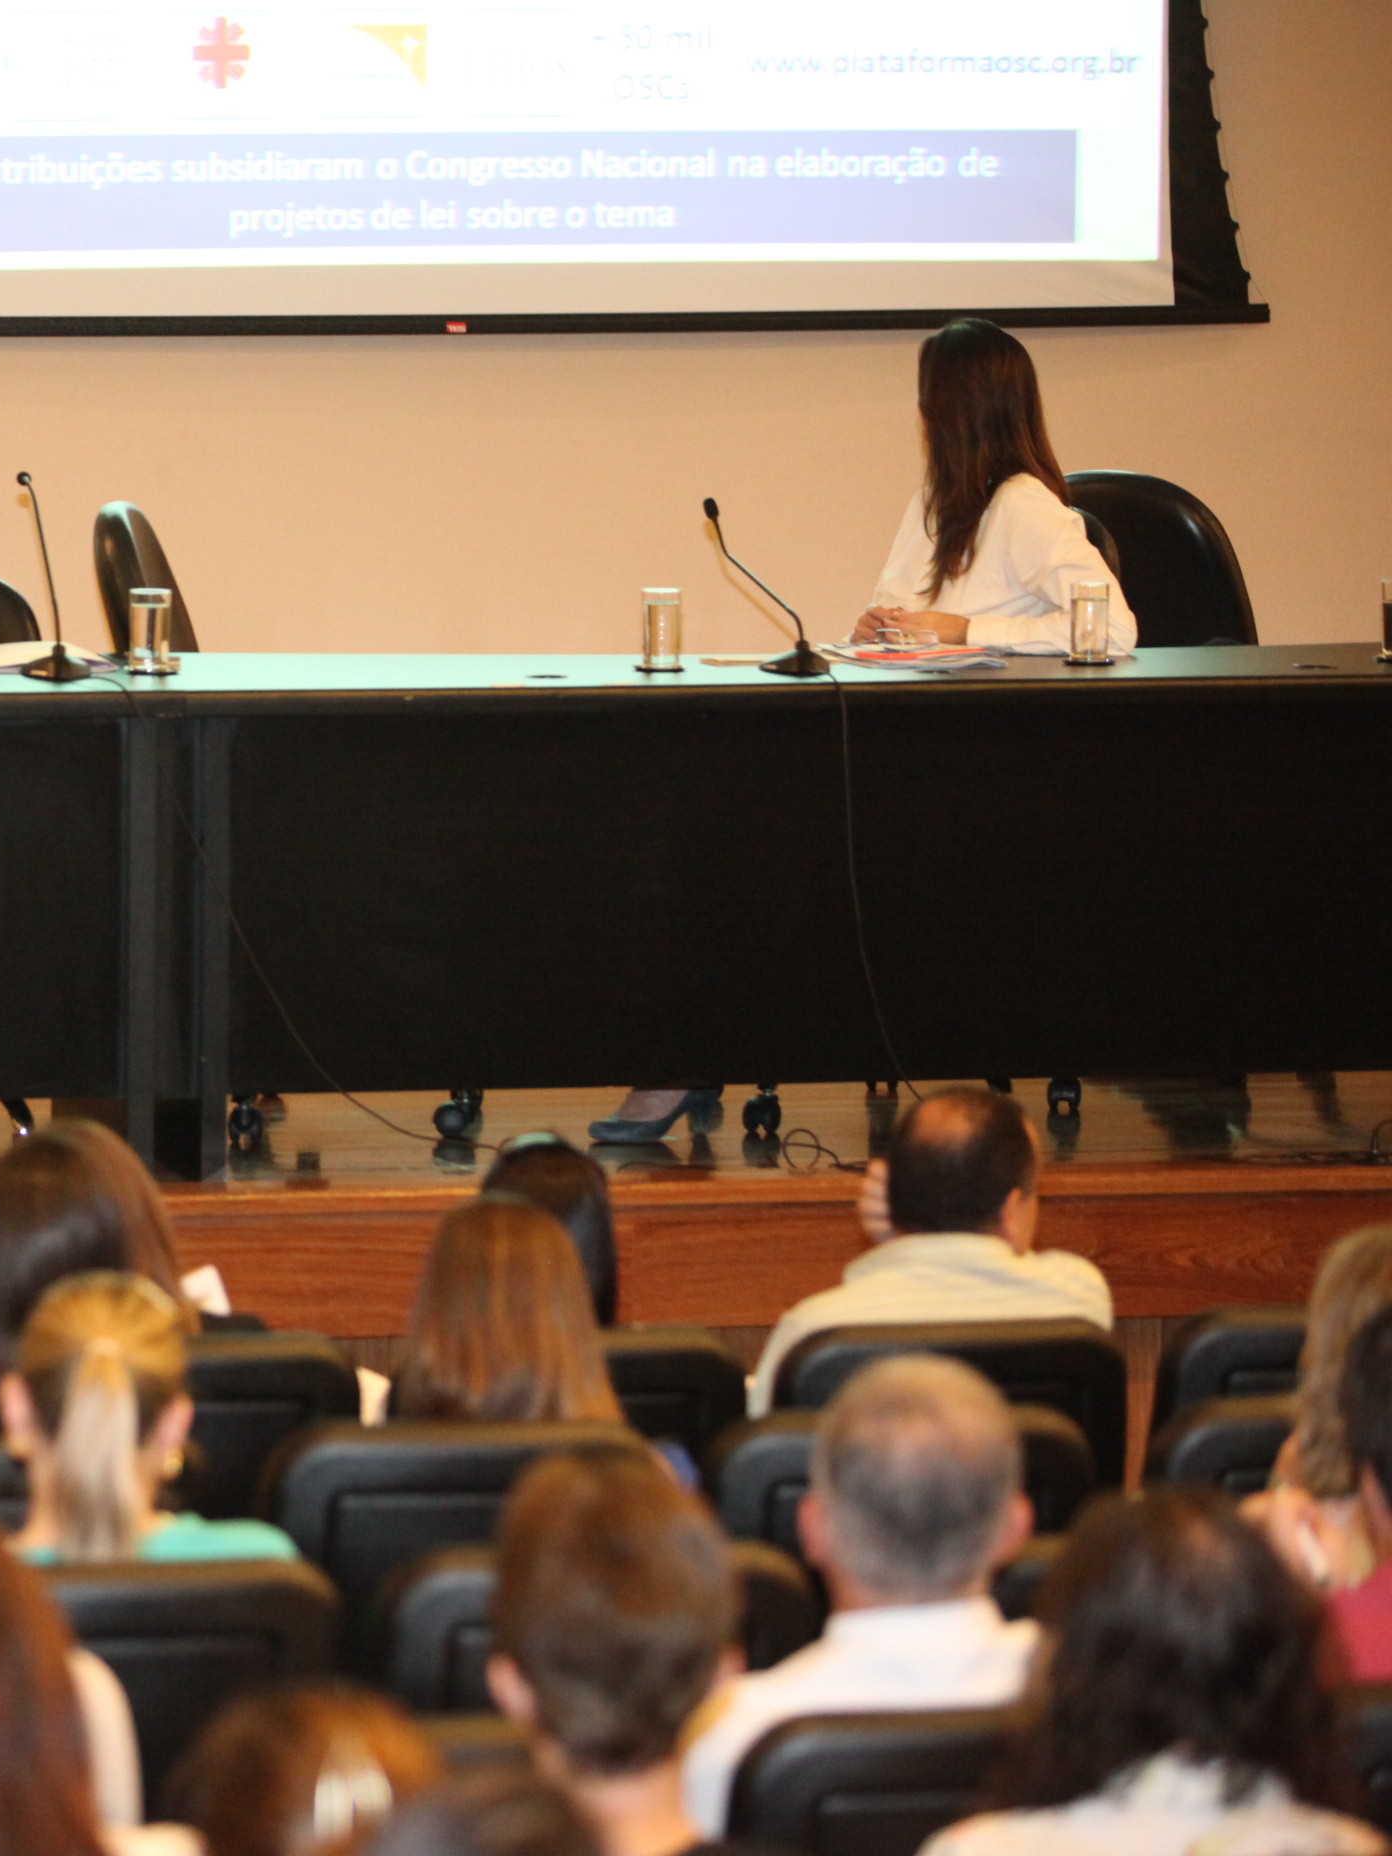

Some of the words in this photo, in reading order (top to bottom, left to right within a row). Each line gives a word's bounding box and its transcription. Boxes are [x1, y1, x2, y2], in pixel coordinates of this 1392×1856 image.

[749, 48, 1138, 81] www.plataformaosc.org.br
[614, 74, 689, 100] OSCs
[171, 152, 363, 181] subsidiaram
[376, 156, 398, 180] o
[405, 150, 572, 186] Congresso
[580, 147, 715, 178] Nacional
[726, 153, 767, 178] na
[774, 146, 946, 184] elaboração
[958, 147, 1000, 178] de
[229, 202, 364, 239] projetos
[370, 200, 412, 231] de
[419, 199, 456, 230] lei
[466, 199, 557, 230] sobre
[564, 204, 586, 229] o
[593, 203, 676, 229] tema
